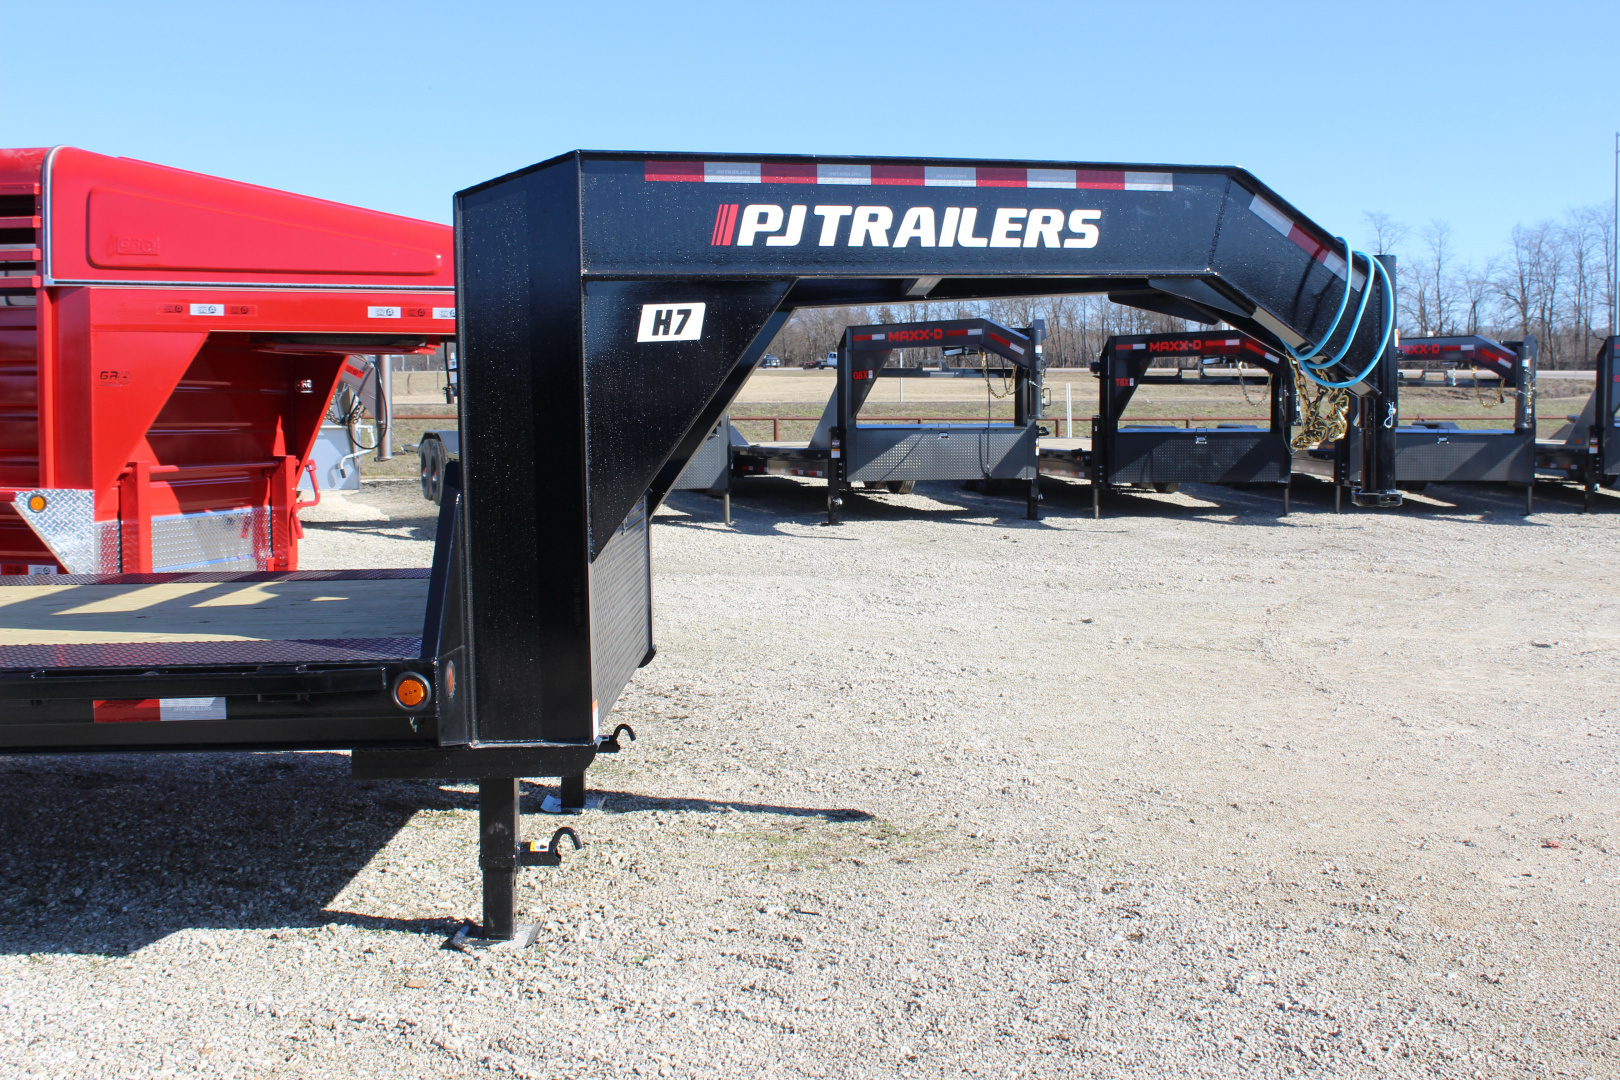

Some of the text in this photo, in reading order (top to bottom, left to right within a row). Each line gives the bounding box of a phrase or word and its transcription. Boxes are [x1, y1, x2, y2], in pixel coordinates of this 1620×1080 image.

[737, 204, 1102, 249] PJ TRAILERS
[652, 309, 692, 336] H7
[888, 328, 943, 343] MAXX-D
[1149, 340, 1202, 352] MAXX-D
[1398, 343, 1440, 355] AXX-D
